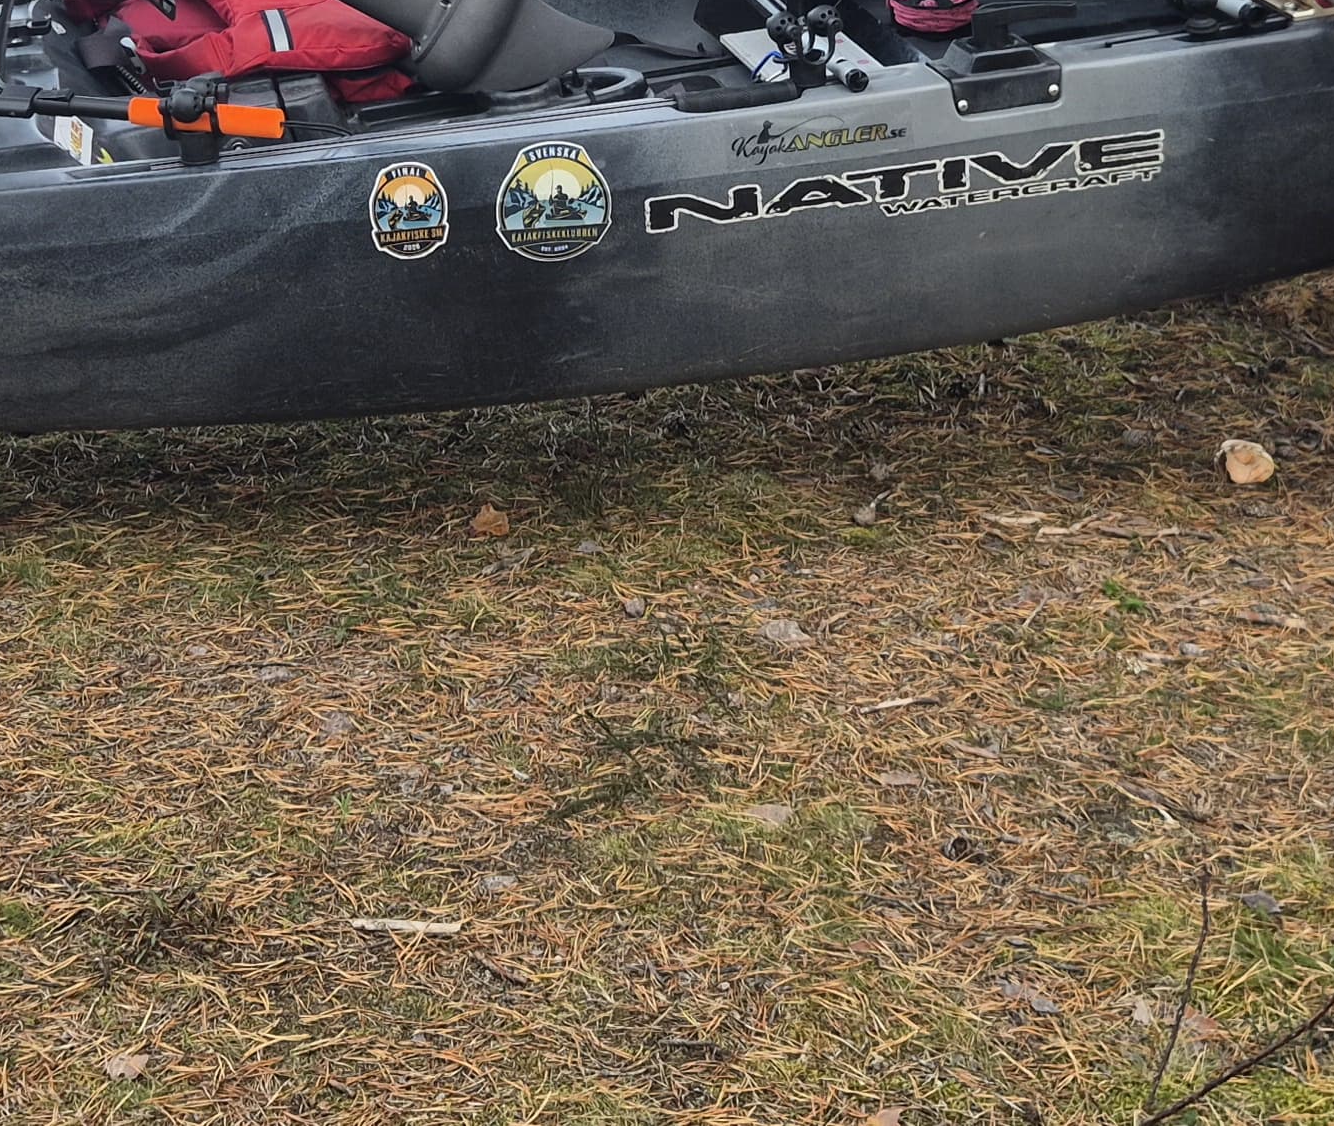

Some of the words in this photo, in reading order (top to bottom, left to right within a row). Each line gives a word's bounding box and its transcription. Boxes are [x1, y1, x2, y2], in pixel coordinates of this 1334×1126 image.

[529, 146, 578, 162] SVENSKA
[391, 167, 421, 178] FINAL
[645, 128, 1166, 234] NATIVE
[880, 166, 1163, 218] WATERCRAFT
